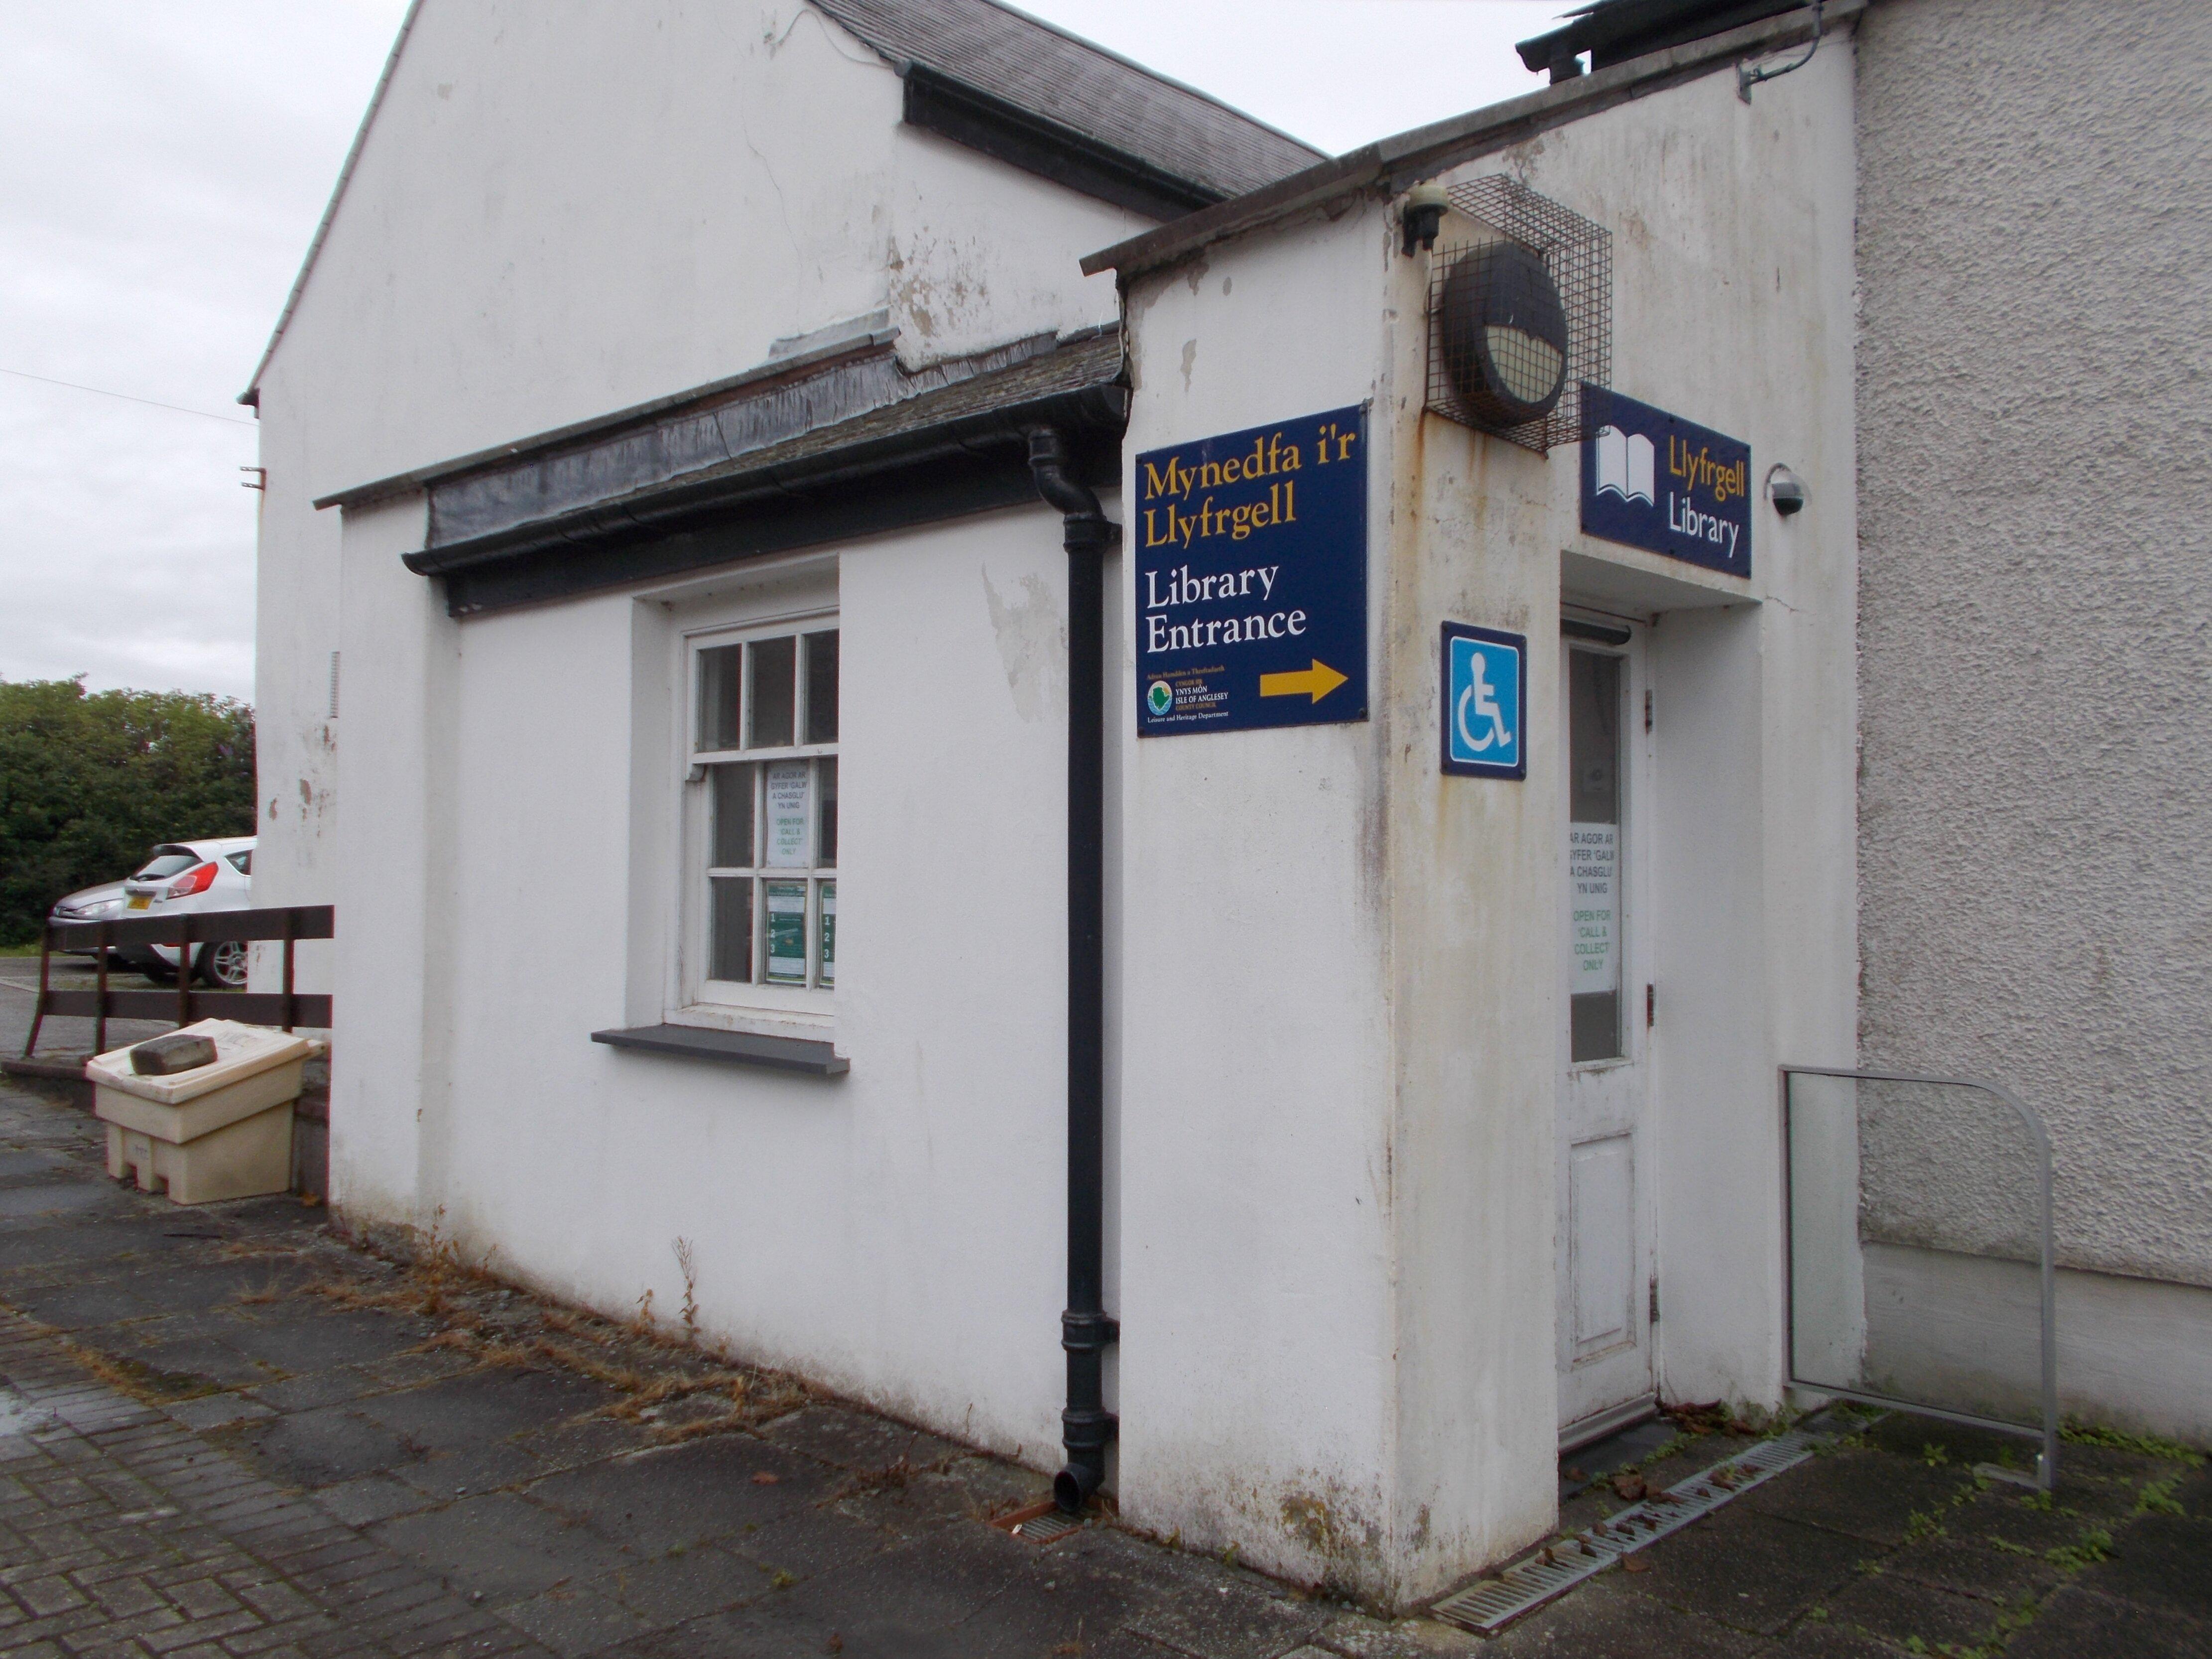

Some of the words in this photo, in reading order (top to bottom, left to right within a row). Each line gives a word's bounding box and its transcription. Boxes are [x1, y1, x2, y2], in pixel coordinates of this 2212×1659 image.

[1144, 432, 1302, 500] Mynedfa
[1317, 424, 1356, 465] i'r
[1670, 435, 1744, 502] Llyfrgell
[1144, 480, 1297, 549] Llyfrgell
[1669, 492, 1739, 558] Library
[1145, 564, 1279, 609] Library
[1145, 609, 1307, 653] Entrance
[1176, 687, 1191, 696] YNYS
[1192, 684, 1207, 694] MÔN
[1198, 692, 1229, 703] ANGLESEY
[1199, 711, 1229, 720] Department
[1581, 832, 1603, 844] AGOR
[1605, 833, 1613, 845] AR
[1577, 883, 1588, 893] YN
[1590, 883, 1608, 894] UNIG
[771, 913, 775, 922] 1
[825, 916, 830, 925] 1
[1573, 910, 1595, 921] OPEN
[1596, 909, 1611, 921] FOR
[770, 929, 775, 938] 2
[825, 932, 830, 942] 2
[770, 944, 775, 953] 3
[825, 949, 829, 958] 3
[1583, 959, 1603, 971] ONLY
